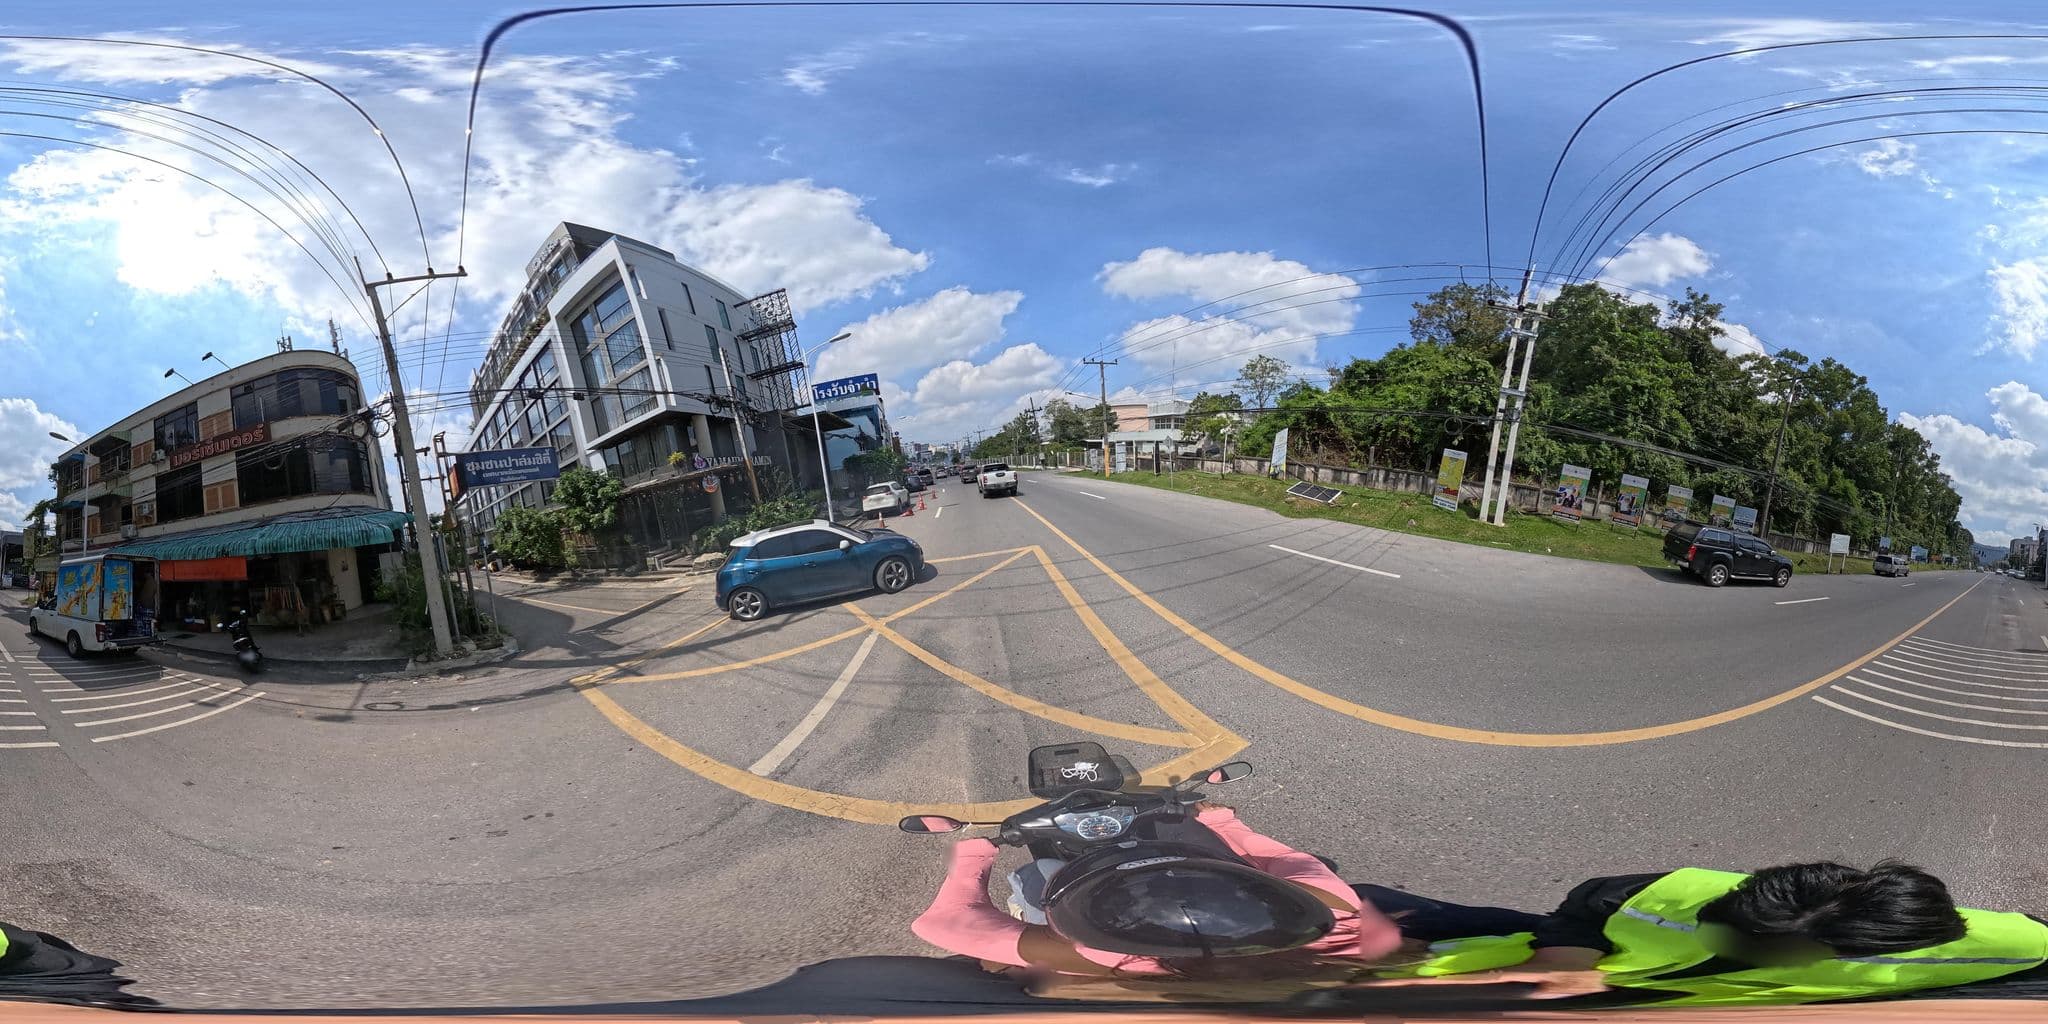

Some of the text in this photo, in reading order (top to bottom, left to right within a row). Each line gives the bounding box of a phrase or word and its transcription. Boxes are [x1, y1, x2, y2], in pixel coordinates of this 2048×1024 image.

[465, 449, 552, 475] ชุมชนปาล์มซิตี้
